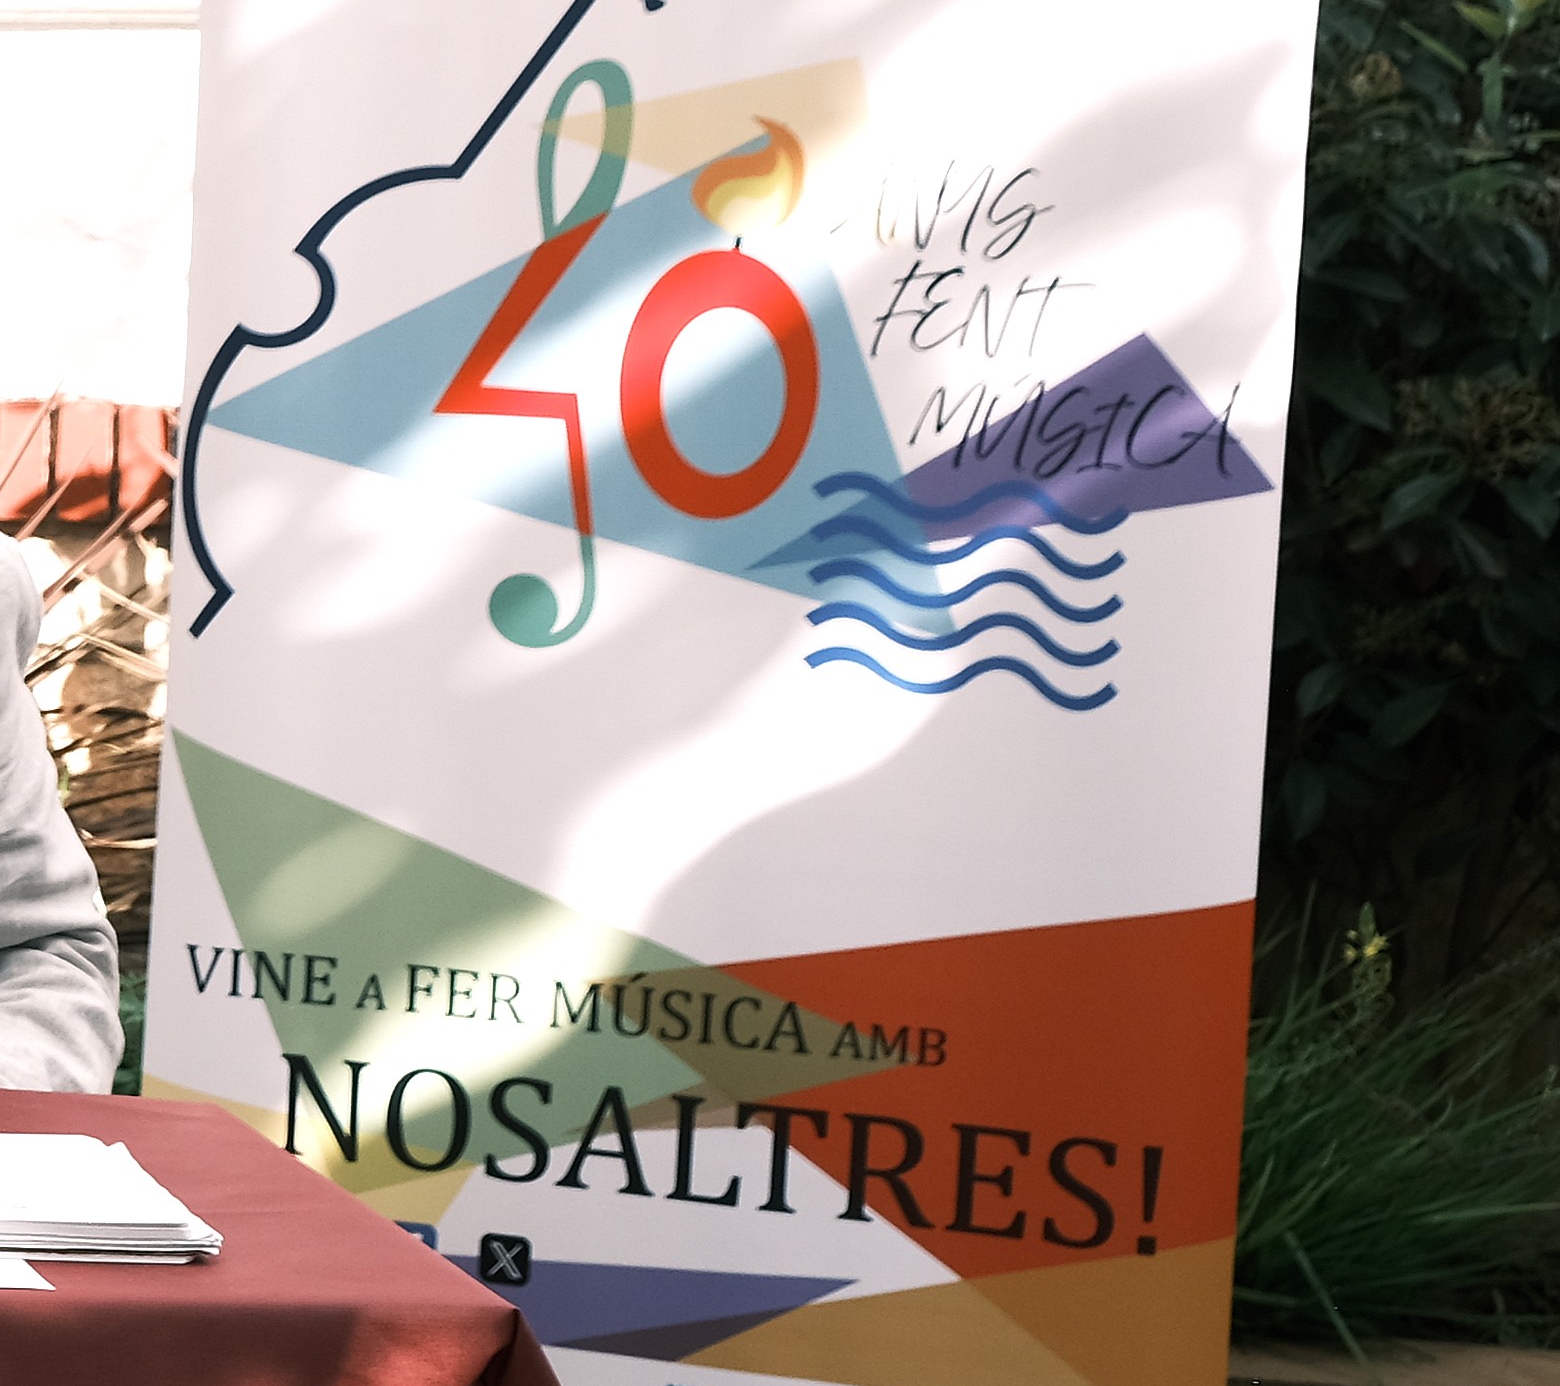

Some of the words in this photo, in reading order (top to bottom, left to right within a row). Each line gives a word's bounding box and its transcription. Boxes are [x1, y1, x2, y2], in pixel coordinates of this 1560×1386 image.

[186, 942, 338, 1009] VINE
[355, 972, 387, 1012] A
[406, 962, 524, 1024] FER
[550, 971, 810, 1057] MÚSICA
[829, 1020, 948, 1069] AMB
[282, 1051, 1166, 1258] NOSALTRES!
